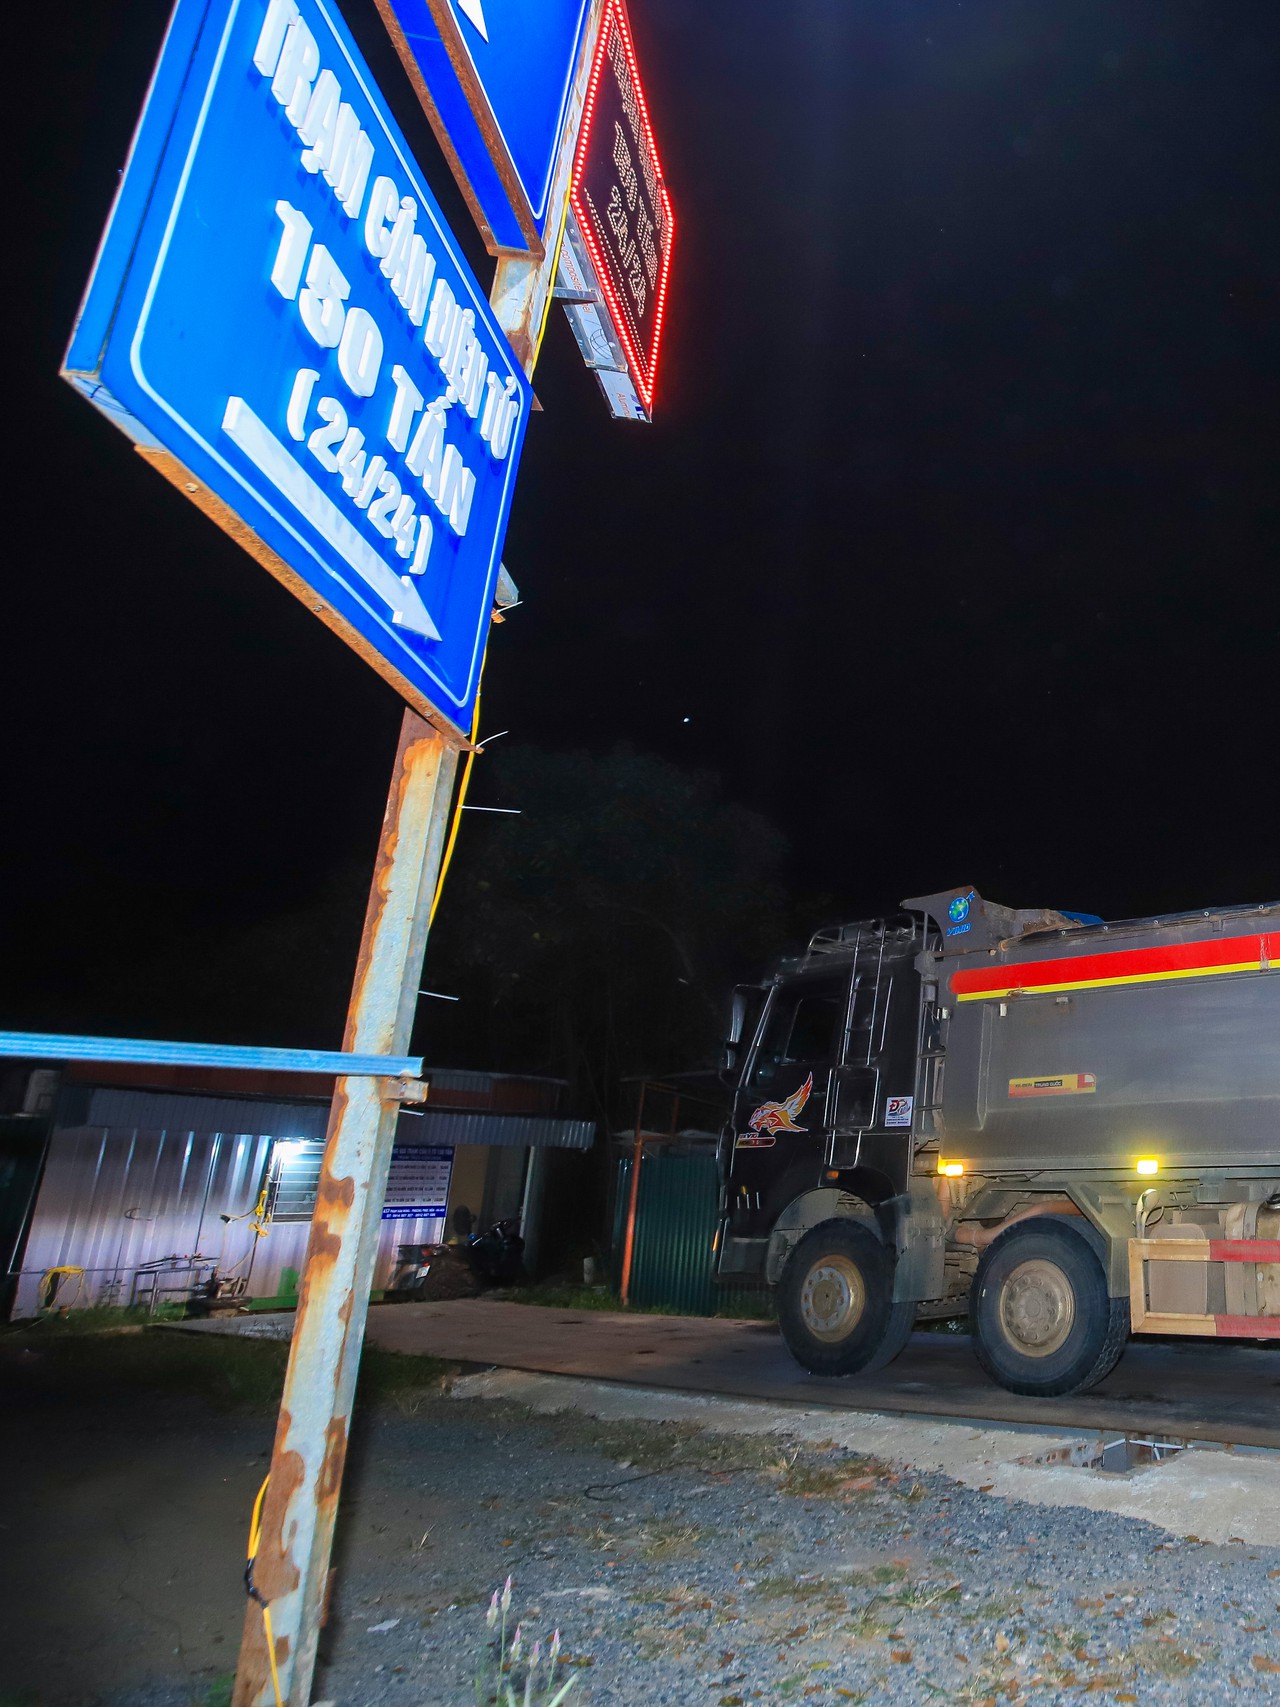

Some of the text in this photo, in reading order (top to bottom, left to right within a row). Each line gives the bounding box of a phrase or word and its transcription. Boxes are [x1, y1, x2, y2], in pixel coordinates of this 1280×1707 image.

[271, 200, 477, 537] 150 TẤN
[365, 176, 436, 326] CÂN
